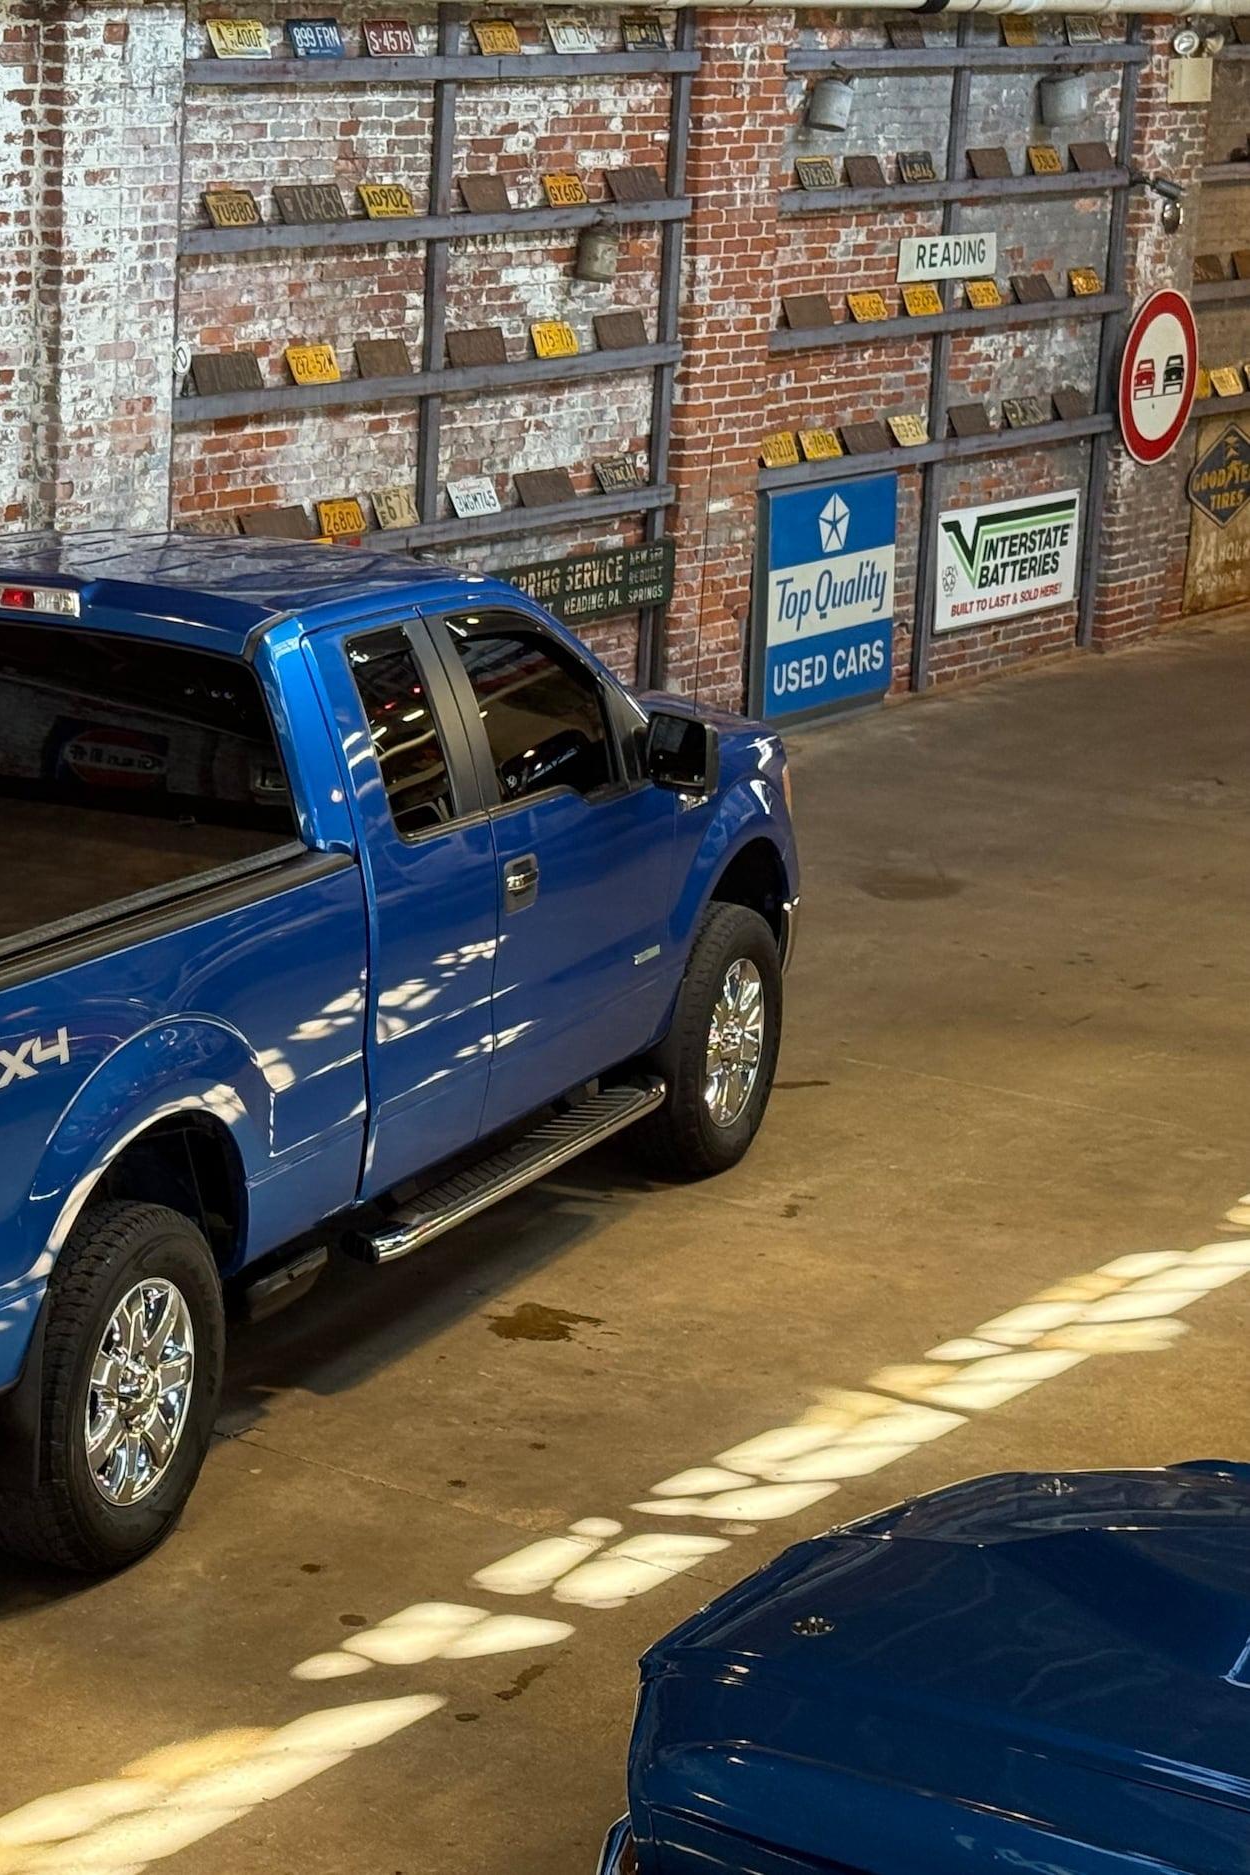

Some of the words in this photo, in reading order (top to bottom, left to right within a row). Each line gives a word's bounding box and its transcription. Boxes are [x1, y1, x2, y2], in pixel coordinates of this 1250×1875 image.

[293, 27, 316, 48] 899
[315, 26, 341, 47] FRN
[367, 188, 409, 209] AD902
[916, 238, 986, 269] READING
[982, 523, 1070, 562] INTERSTATE
[565, 555, 624, 592] SERVICE
[978, 551, 1060, 589] BATTERIES
[628, 584, 664, 604] SPRINGS
[776, 577, 811, 632] Top
[815, 560, 888, 620] Quality
[950, 600, 975, 617] BUILT
[976, 598, 988, 611] TO
[989, 595, 1010, 609] LAST
[1012, 592, 1018, 605] &
[1019, 588, 1039, 603] SOLD
[773, 654, 828, 696] USED
[833, 639, 884, 681] CARS
